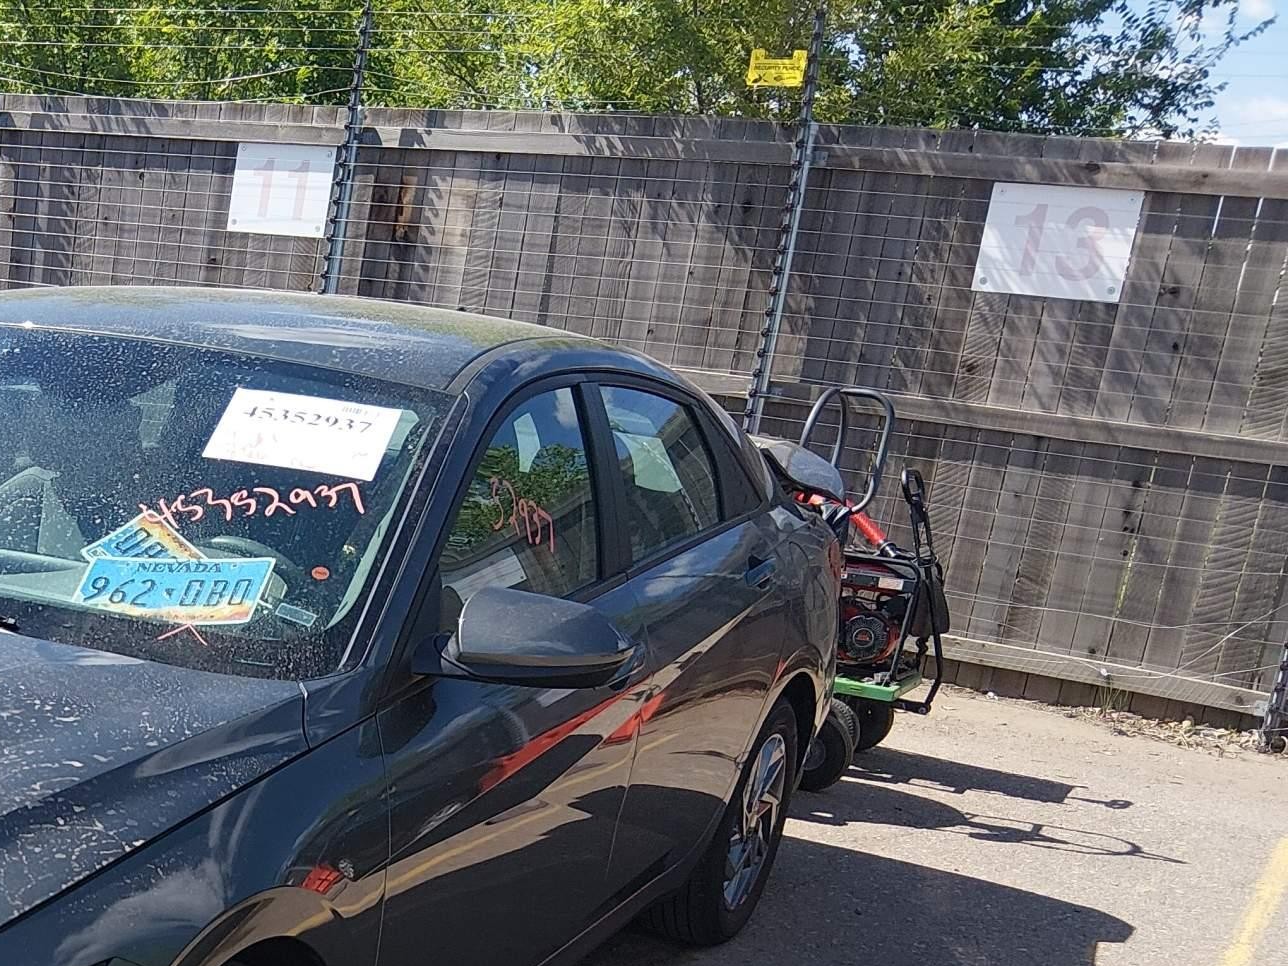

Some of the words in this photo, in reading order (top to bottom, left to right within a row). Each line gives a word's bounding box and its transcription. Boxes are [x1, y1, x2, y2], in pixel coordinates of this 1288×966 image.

[253, 158, 311, 220] 11
[1014, 203, 1110, 281] 13
[243, 405, 373, 433] 45352937
[138, 482, 365, 529] 45352937
[137, 562, 222, 573] NEVADA
